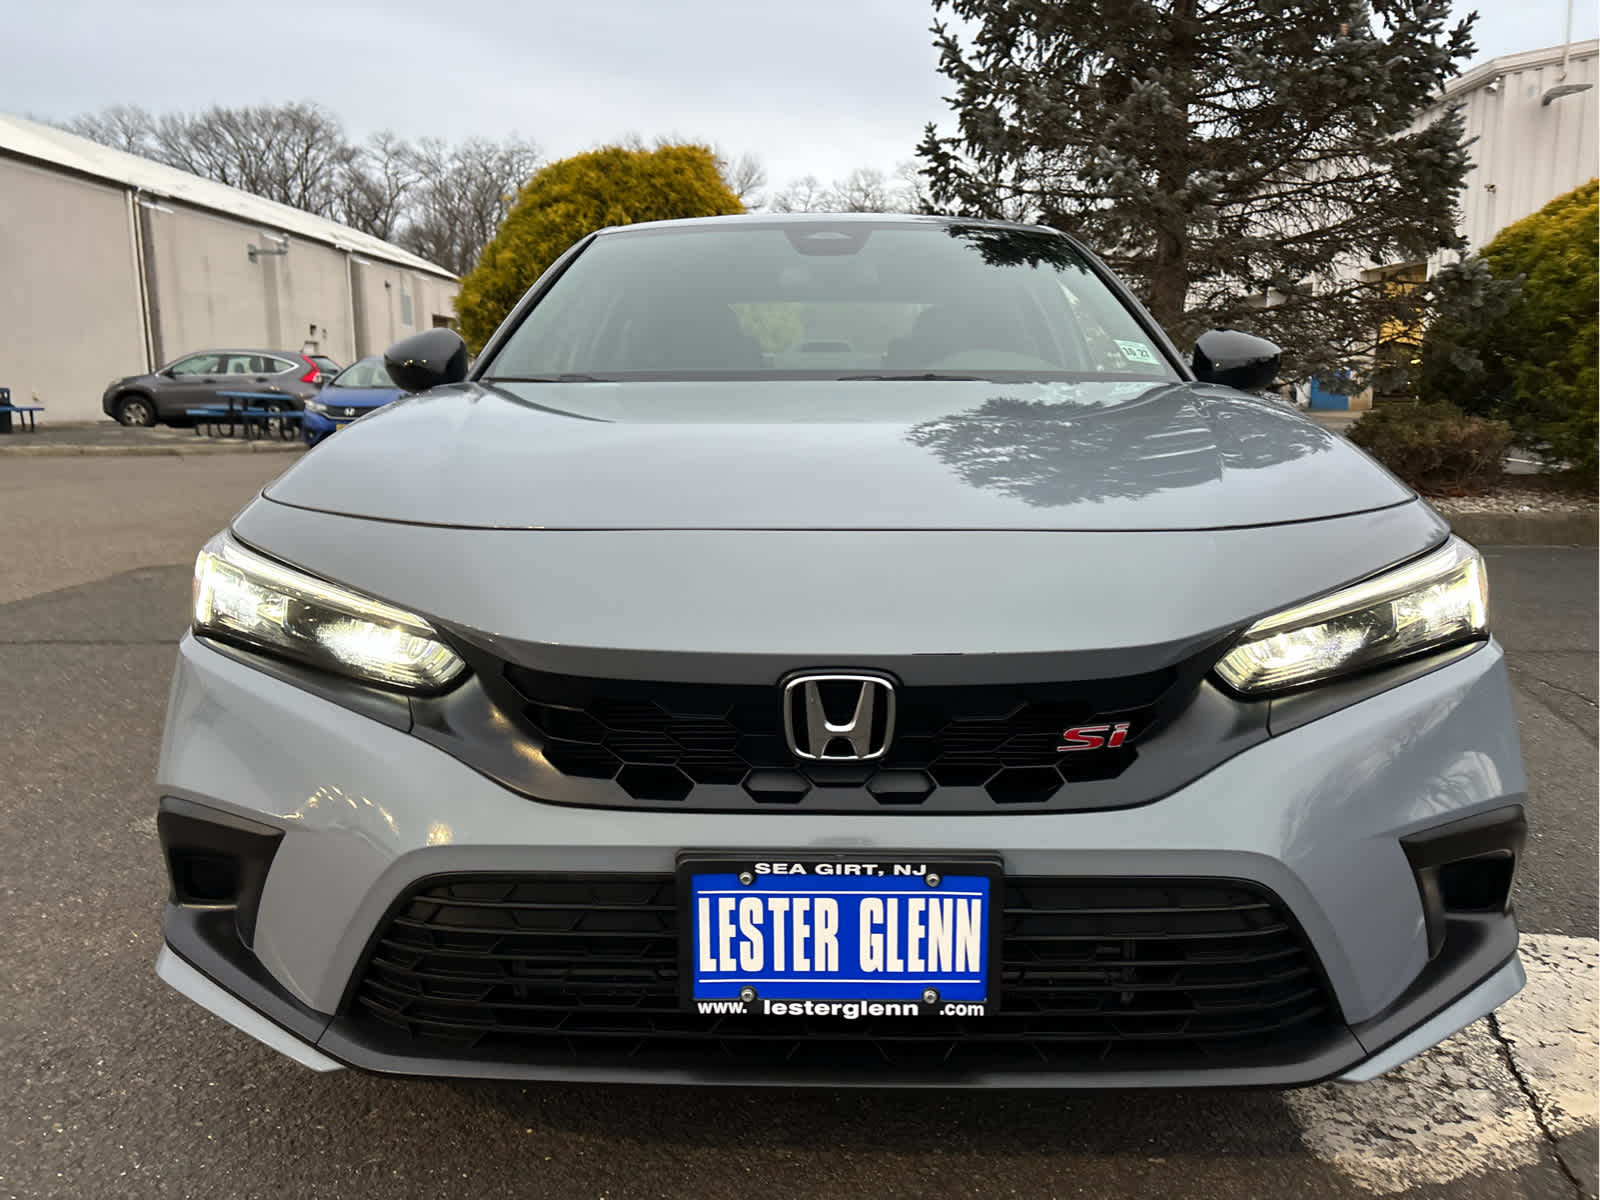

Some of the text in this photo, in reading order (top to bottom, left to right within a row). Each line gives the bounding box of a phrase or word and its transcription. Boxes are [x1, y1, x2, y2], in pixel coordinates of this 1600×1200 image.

[1057, 723, 1130, 752] Si
[754, 863, 927, 877] SEA GIRT, NJ
[698, 897, 982, 972] LESTER GLENN
[697, 999, 985, 1020] www. lesterglenn .com
